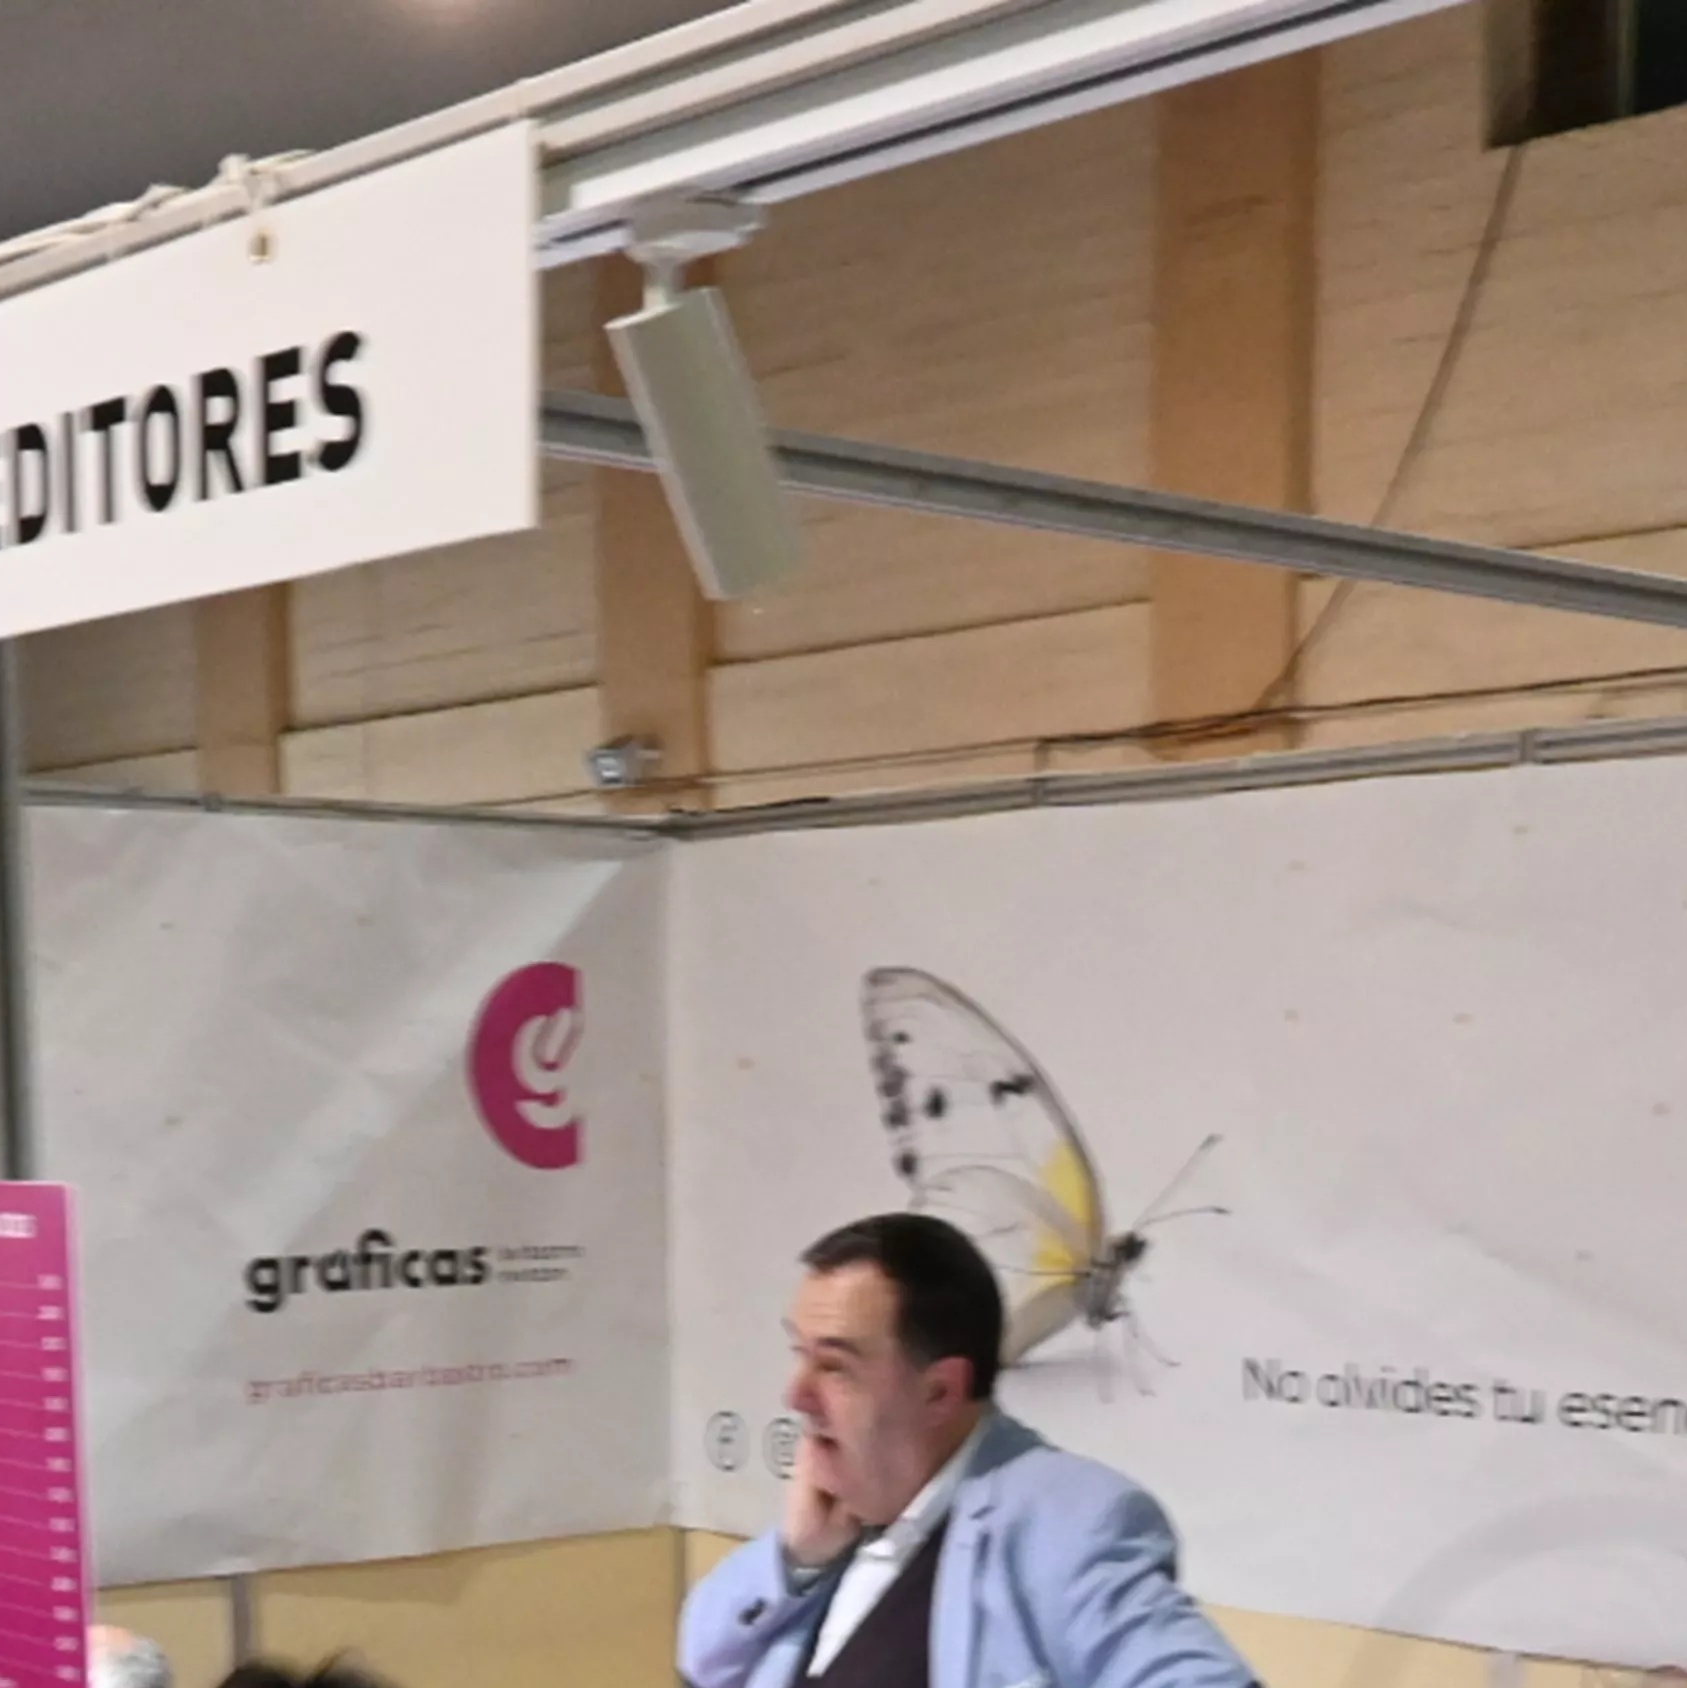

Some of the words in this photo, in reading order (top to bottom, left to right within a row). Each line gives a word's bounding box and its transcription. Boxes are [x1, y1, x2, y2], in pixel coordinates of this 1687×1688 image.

[1242, 1356, 1309, 1405] No
[1315, 1362, 1481, 1419] olvides
[1491, 1377, 1546, 1425] tu
